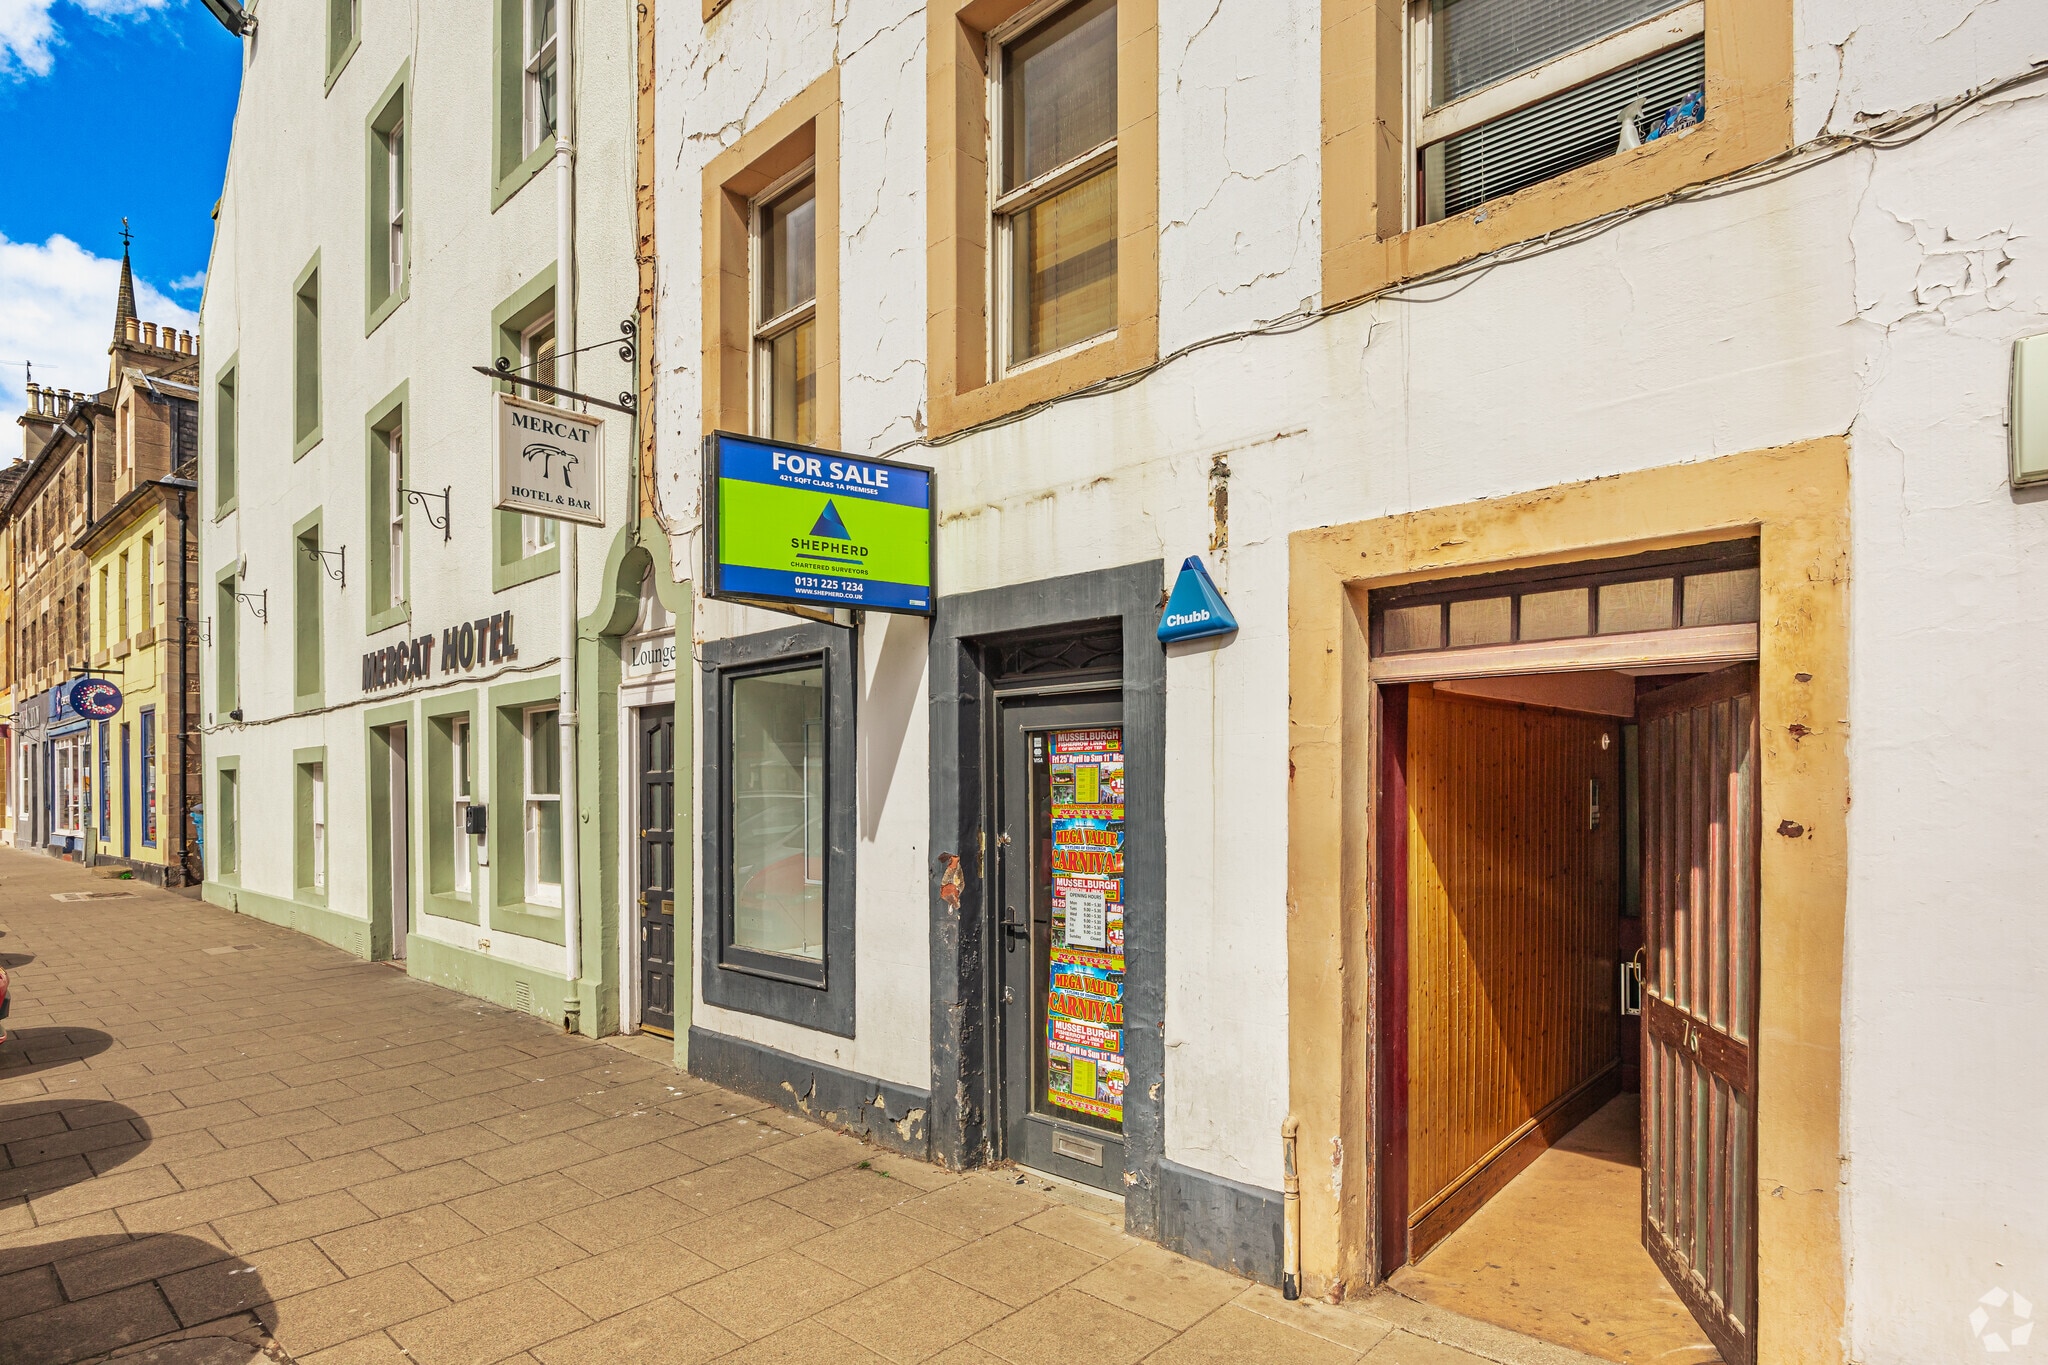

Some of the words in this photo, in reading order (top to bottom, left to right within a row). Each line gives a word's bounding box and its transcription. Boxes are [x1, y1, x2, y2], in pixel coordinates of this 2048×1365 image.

[511, 411, 590, 443] MERCAT
[772, 452, 822, 477] FOR
[829, 462, 889, 488] SALE
[779, 474, 793, 482] 421
[794, 476, 811, 485] SQFT
[812, 479, 834, 488] CLASS
[836, 482, 845, 490] 1A
[846, 485, 879, 495] PREMISES
[511, 486, 553, 503] HOTEL
[555, 494, 564, 505] &
[568, 498, 591, 510] BAR
[791, 538, 869, 557] SHEPHERD
[790, 561, 830, 571] CHARTERED
[831, 566, 869, 576] SURVEYORS
[794, 576, 818, 587] 0131
[821, 579, 838, 590] 225
[841, 582, 864, 593] 1234
[794, 587, 863, 600] WWW.SHEPHERD.CO.UK
[1166, 609, 1210, 627] Chubb
[362, 633, 433, 691] MERCAT
[440, 610, 516, 672] HOTEL
[632, 645, 676, 668] Lounge
[1057, 730, 1119, 742] MUSSELBURGH
[1056, 828, 1083, 845] MEGA
[1083, 829, 1118, 847] VALUE
[1056, 877, 1117, 890] MUSSELBURGH
[1057, 953, 1112, 965] MATRIX
[1055, 974, 1083, 991] MEGA
[1083, 975, 1118, 998] VALUE
[1055, 1020, 1117, 1040] MUSSELBURGH
[1066, 1043, 1080, 1056] April
[1088, 1049, 1100, 1061] Sun
[1055, 1095, 1110, 1115] MATRIX
